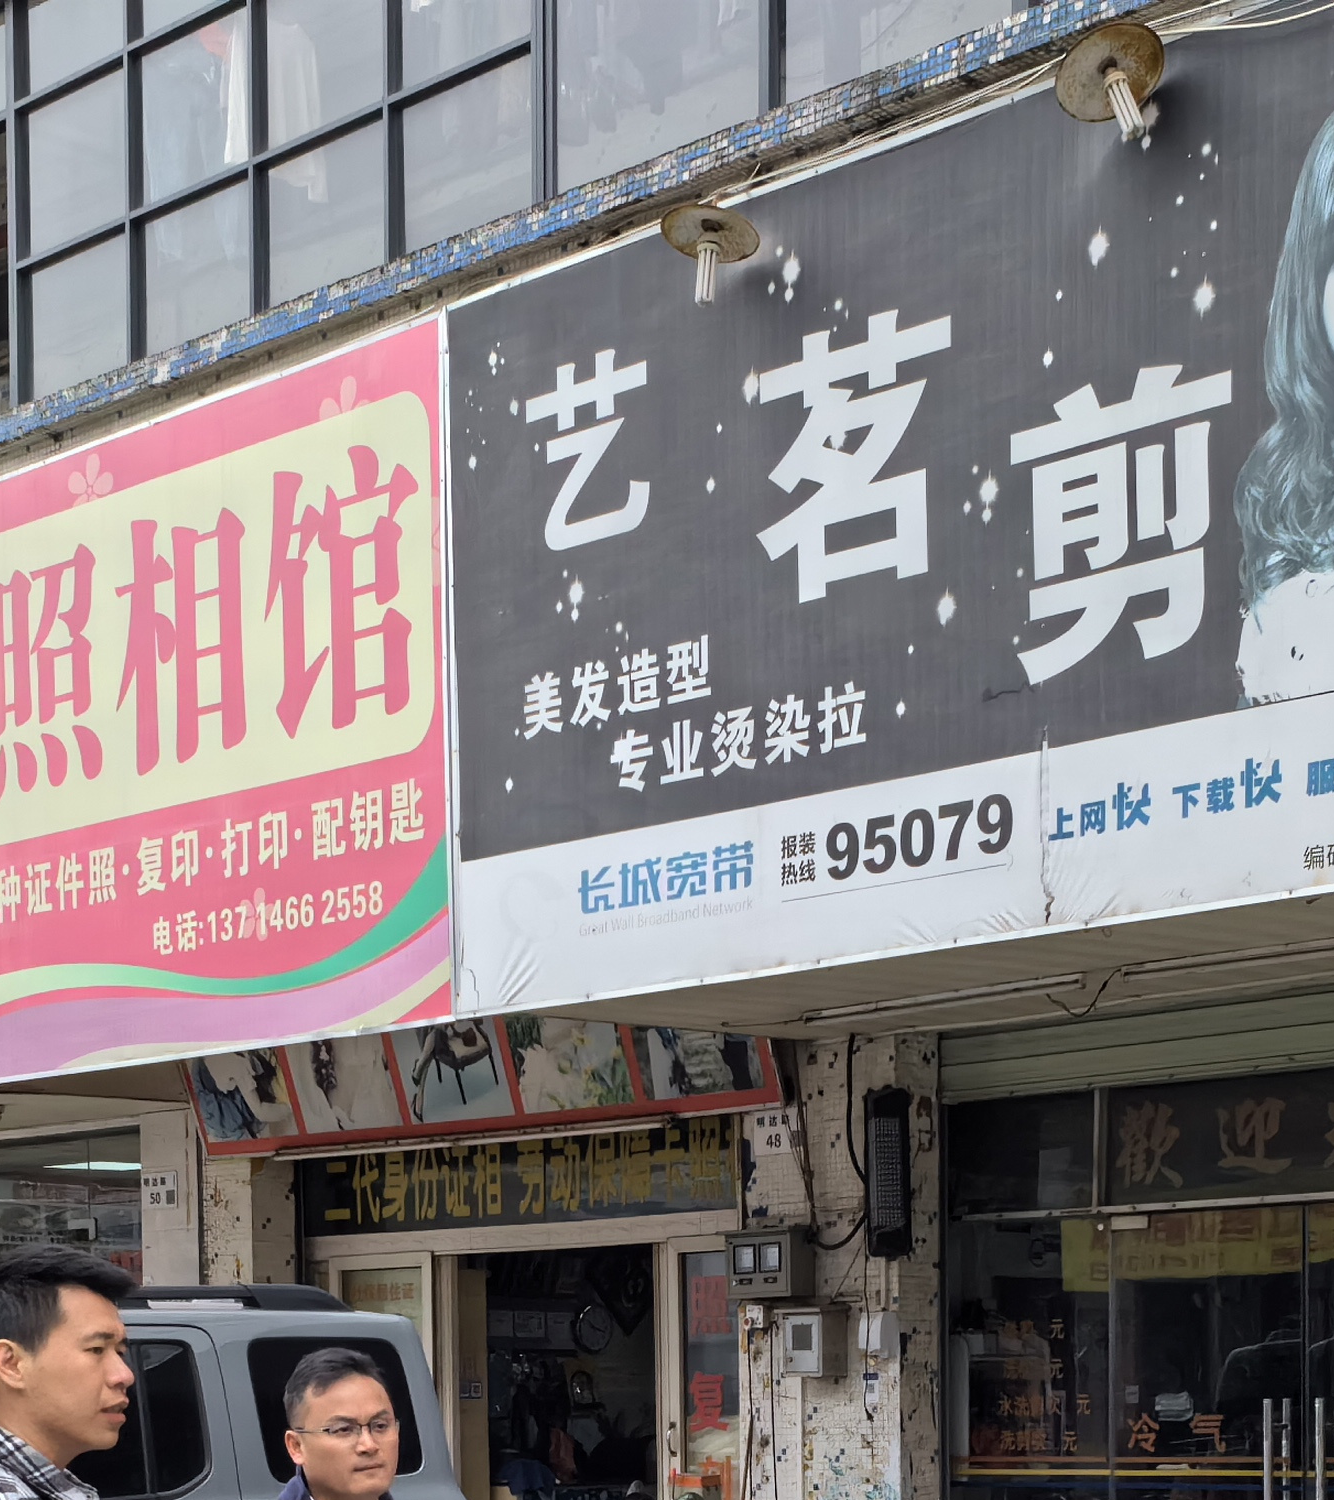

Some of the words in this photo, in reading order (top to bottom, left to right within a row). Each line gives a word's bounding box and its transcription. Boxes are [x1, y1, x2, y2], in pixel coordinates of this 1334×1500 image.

[526, 308, 1232, 689] 艺茗剪
[522, 634, 712, 741] 美发造型
[609, 680, 868, 793] 专业烫染拉
[1048, 781, 1152, 842] 上网快
[1171, 757, 1283, 820] 下载快
[780, 831, 817, 861] 报装
[825, 792, 1014, 881] 95079
[578, 839, 755, 915] 长城宽带
[780, 861, 817, 887] 热线
[321, 880, 384, 926] 2558
[612, 914, 634, 932] Wall
[637, 903, 700, 928] Broadband
[766, 1133, 782, 1149] 48
[149, 1192, 162, 1205] 50
[1125, 1411, 1227, 1454] 冷气
